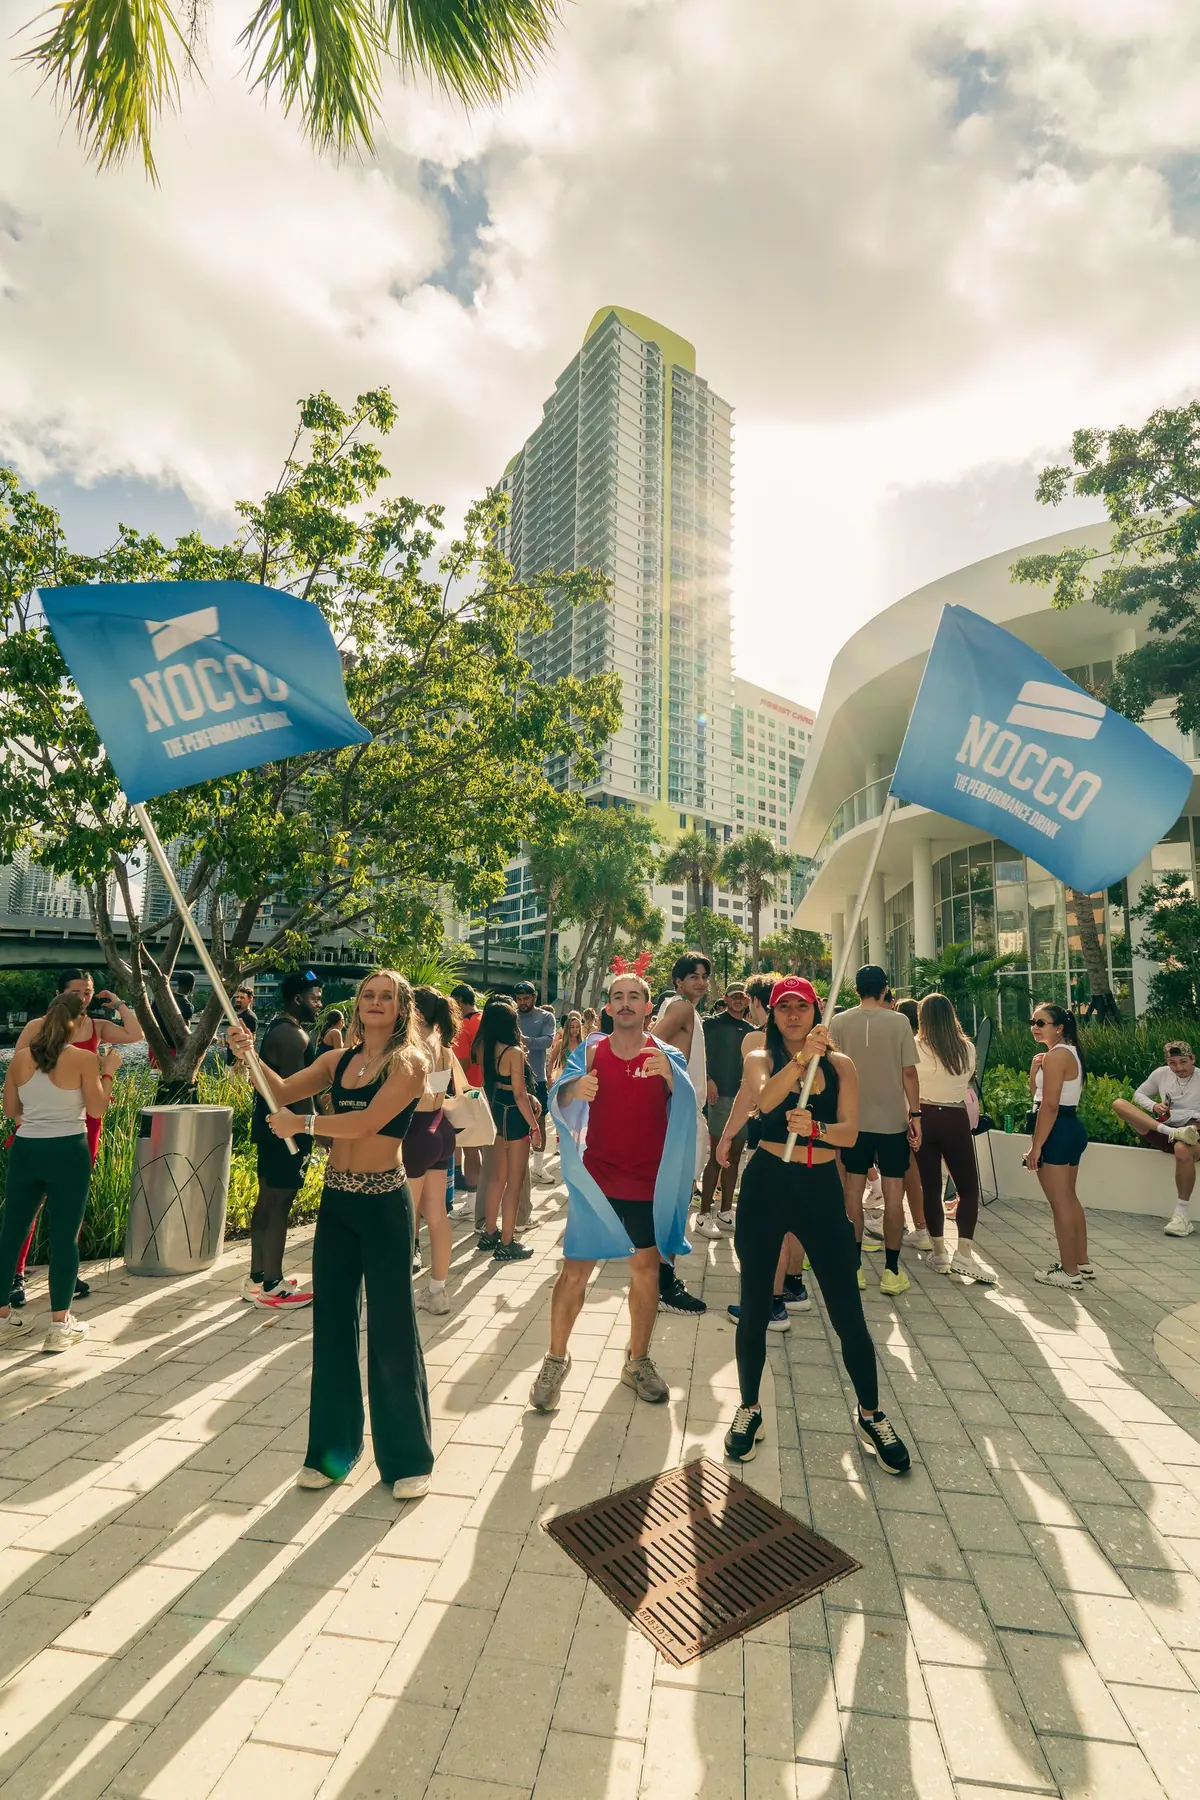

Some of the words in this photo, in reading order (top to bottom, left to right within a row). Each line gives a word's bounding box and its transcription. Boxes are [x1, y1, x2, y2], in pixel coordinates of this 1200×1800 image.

[130, 654, 289, 733] NOCCO
[953, 772, 971, 793] THE
[966, 777, 1034, 822] PERFORMANCE
[1027, 809, 1062, 840] DRINK
[955, 714, 1103, 821] NOCCO
